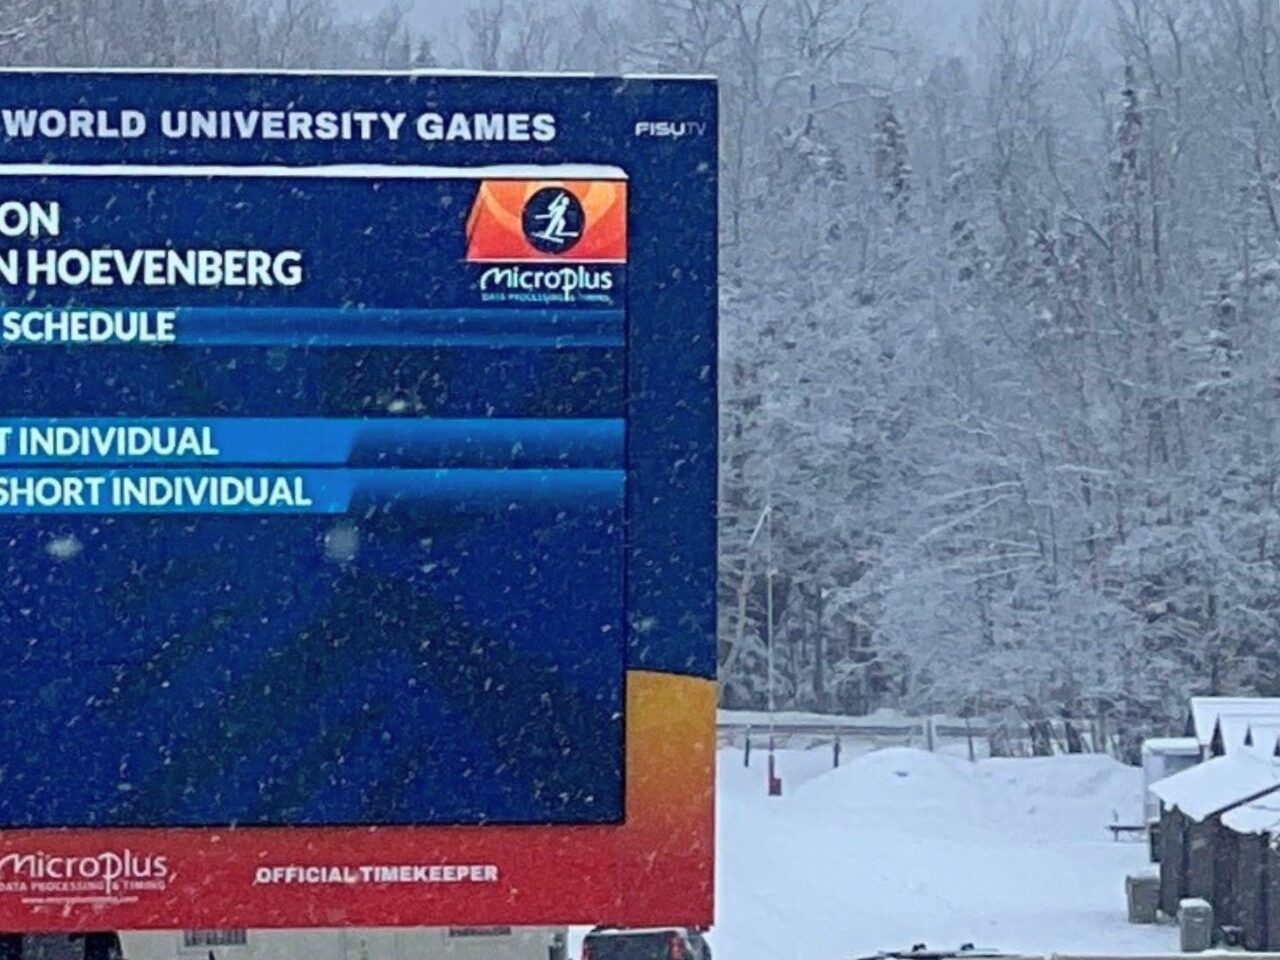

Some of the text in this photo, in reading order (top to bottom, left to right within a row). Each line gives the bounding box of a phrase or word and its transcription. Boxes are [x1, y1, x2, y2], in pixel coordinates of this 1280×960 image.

[2, 109, 146, 140] WORLD
[161, 110, 407, 141] UNIVERSITY
[417, 113, 557, 142] GAMES
[28, 248, 304, 288] HOEVENBERG
[480, 266, 613, 301] Microplus
[2, 310, 176, 343] SCHEDULE
[20, 425, 220, 457] INDIVIDUAL
[113, 476, 313, 508] INDIVIDUAL
[31, 880, 104, 892] PROCESSING
[123, 879, 167, 891] TIMING
[255, 863, 500, 885] OFFICIAL TIMEKEEPER
